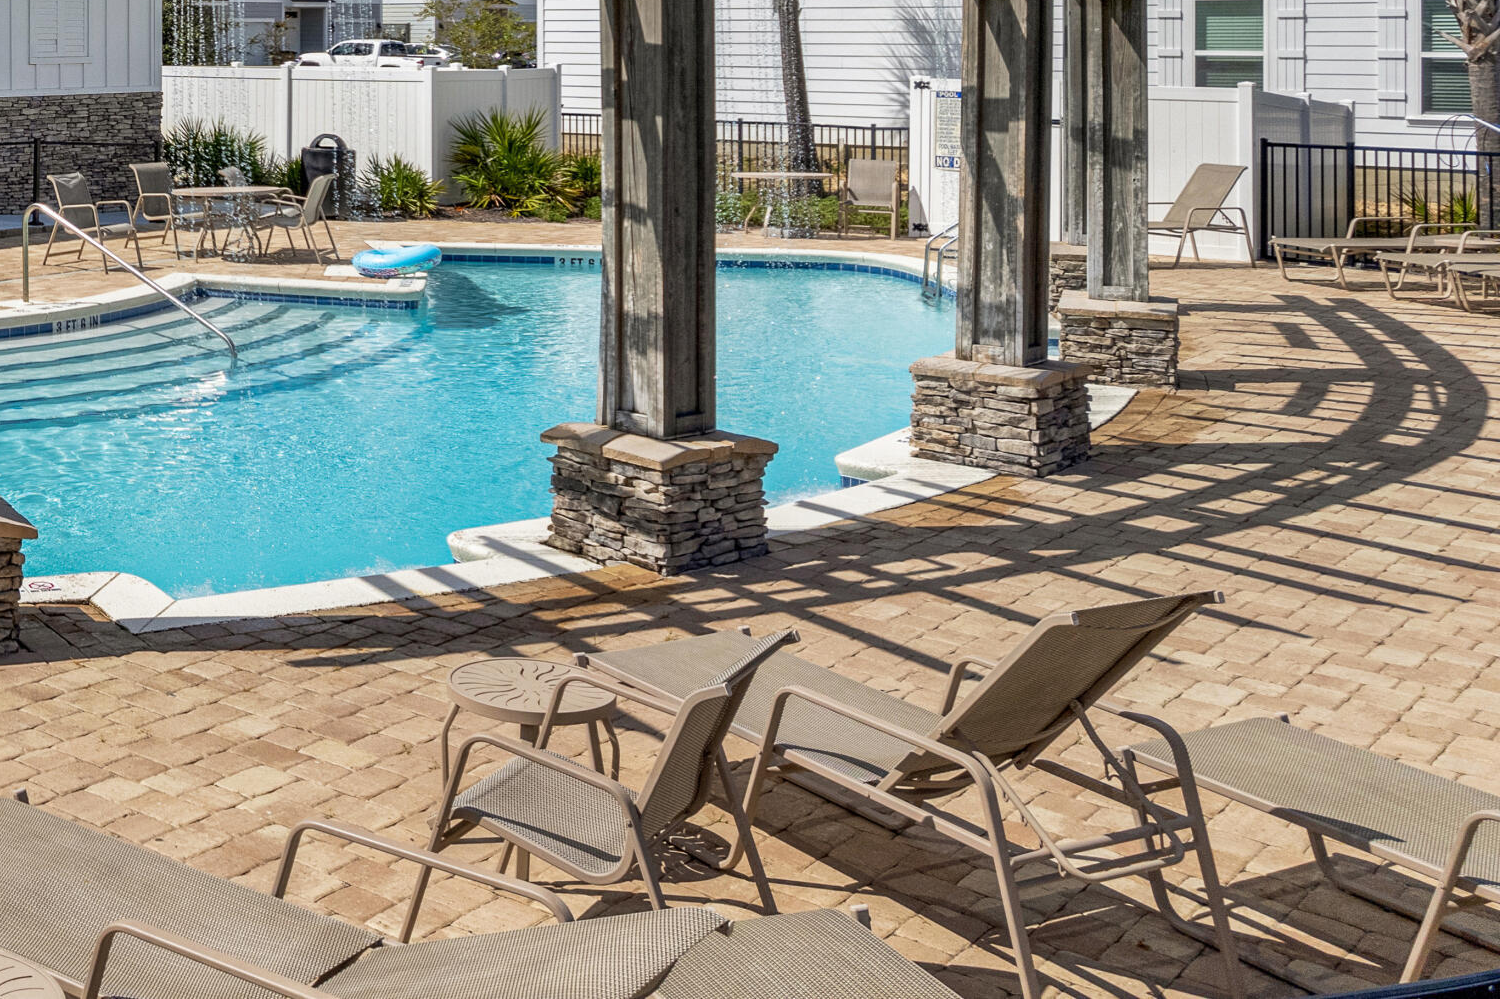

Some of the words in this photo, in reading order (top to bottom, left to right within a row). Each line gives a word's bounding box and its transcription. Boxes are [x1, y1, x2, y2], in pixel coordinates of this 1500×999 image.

[937, 157, 949, 167] NO
[66, 320, 76, 330] FT
[90, 316, 98, 327] IN
